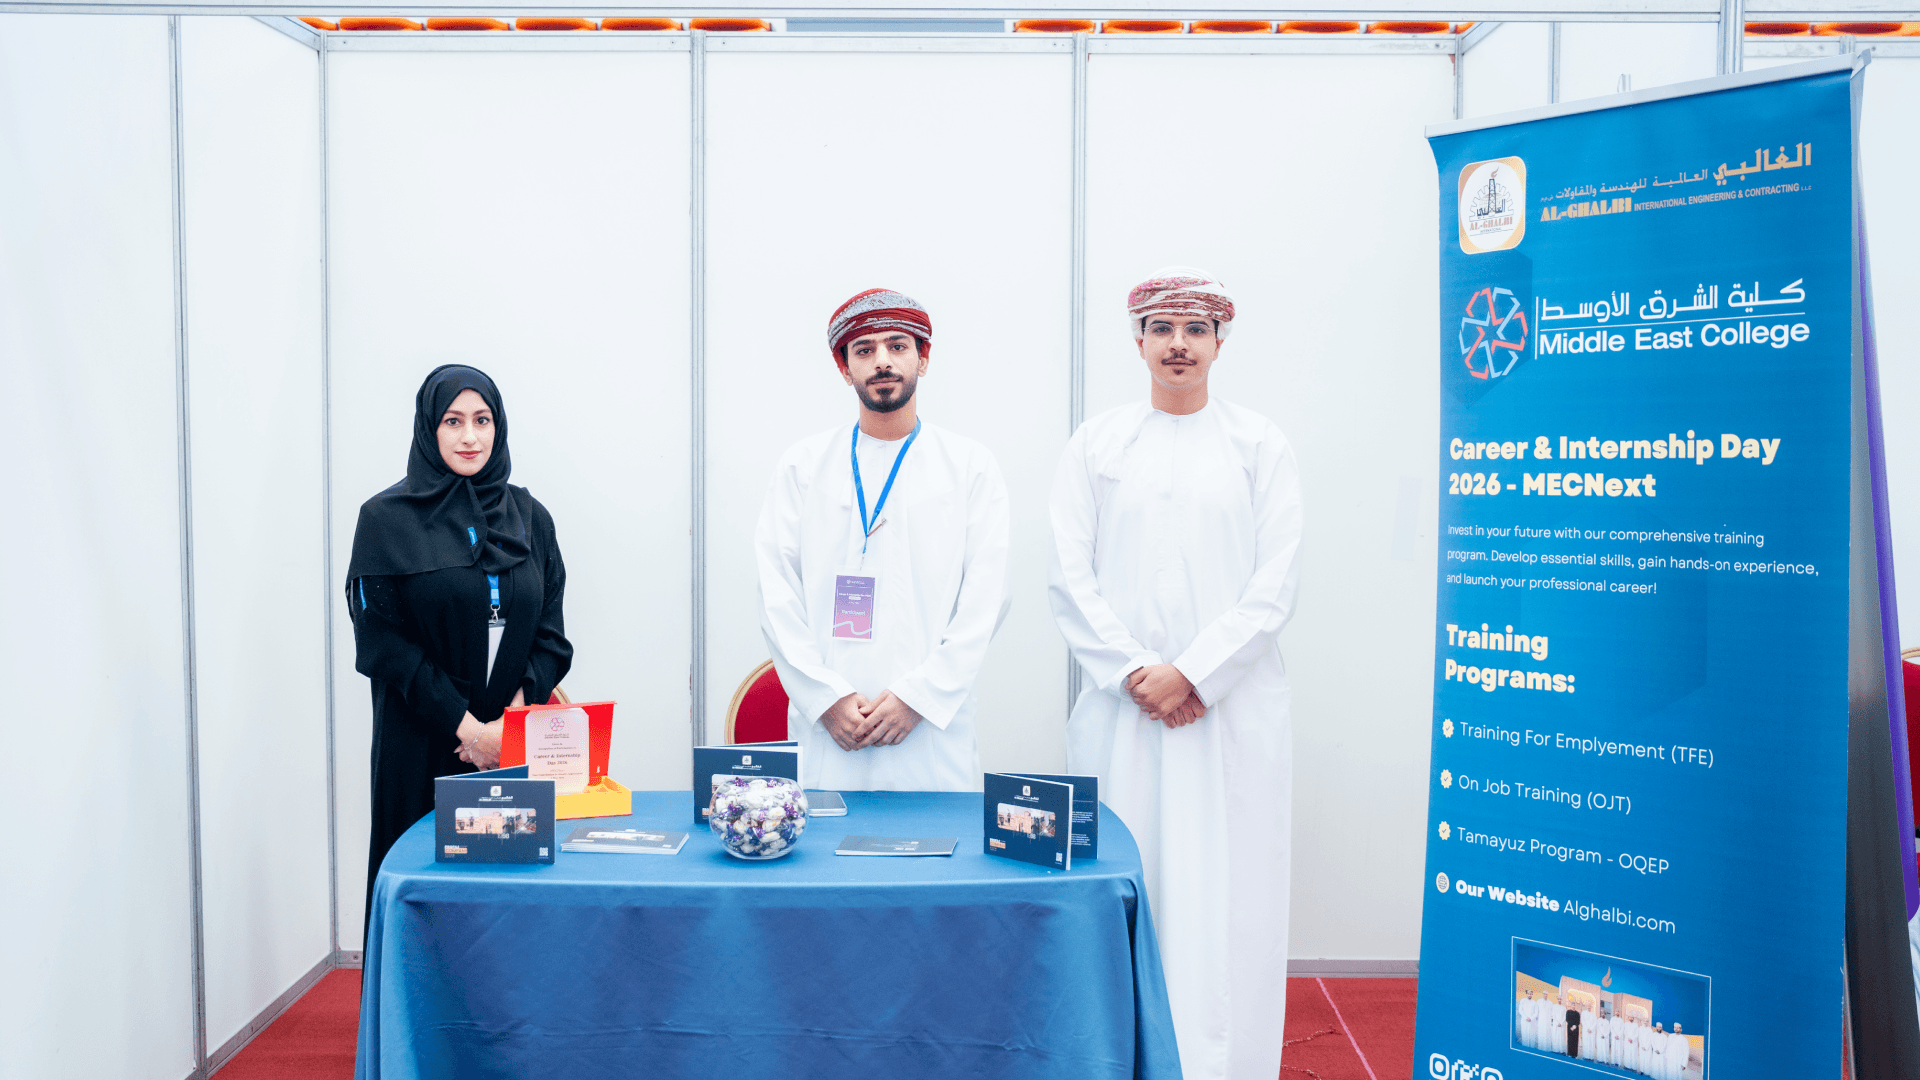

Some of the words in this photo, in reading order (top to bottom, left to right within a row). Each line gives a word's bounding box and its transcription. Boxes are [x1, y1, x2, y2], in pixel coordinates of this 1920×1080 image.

[1713, 142, 1811, 186] الغالبي
[1540, 197, 1632, 222] AL-GHALBI
[1634, 198, 1687, 212] INTERNATIONAL
[1688, 190, 1737, 205] ENGINEERING
[1738, 190, 1744, 198] &
[1745, 183, 1800, 198] CONTRACTING
[1555, 184, 1597, 200] والمقاولات
[1599, 178, 1647, 193] للهندسة
[1470, 216, 1513, 231] AL-GHALBI
[1541, 291, 1630, 323] الأوسط
[1639, 283, 1718, 320] الشرق
[1728, 278, 1806, 313] كلية
[1540, 330, 1625, 355] Middle
[1635, 326, 1693, 350] East
[1701, 321, 1810, 349] College
[1450, 437, 1528, 460] Career
[1534, 436, 1552, 459] &
[1559, 430, 1714, 465] Internship
[1721, 433, 1781, 465] Day
[1449, 473, 1501, 495] 2026
[1523, 473, 1656, 497] MECNext
[1448, 524, 1473, 536] Invest
[1475, 525, 1484, 536] in
[1487, 527, 1511, 539] your
[1514, 525, 1551, 538] future
[1554, 526, 1581, 539] with
[1584, 529, 1606, 540] our
[1609, 529, 1711, 543] comprehensive
[1714, 531, 1764, 548] training
[1447, 550, 1488, 562] program.
[1491, 550, 1538, 565] Develop
[1541, 553, 1596, 566] essential
[1600, 553, 1635, 568] skills,
[1638, 556, 1666, 570] gain
[1670, 556, 1731, 571] hands-on
[1733, 560, 1819, 576] experience,
[1446, 573, 1461, 584] and
[1463, 573, 1497, 586] launch
[1500, 577, 1526, 589] your
[1529, 577, 1606, 592] professional
[1609, 582, 1657, 594] career!
[1446, 622, 1549, 661] Training
[1445, 659, 1575, 694] Programs:
[1460, 722, 1520, 746] Training
[1526, 729, 1551, 746] For
[1556, 733, 1665, 760] Emplyement
[1671, 745, 1714, 768] (TFE)
[1458, 775, 1478, 791] On
[1483, 778, 1510, 795] Job
[1515, 782, 1581, 809] Training
[1587, 791, 1631, 815] (OJT)
[1457, 827, 1525, 852] Tamayuz
[1531, 839, 1601, 864] Program
[1619, 853, 1669, 875] OQEP
[1455, 880, 1485, 898] Our
[1488, 885, 1560, 912] Website
[1563, 900, 1676, 934] Alghalbi.com
